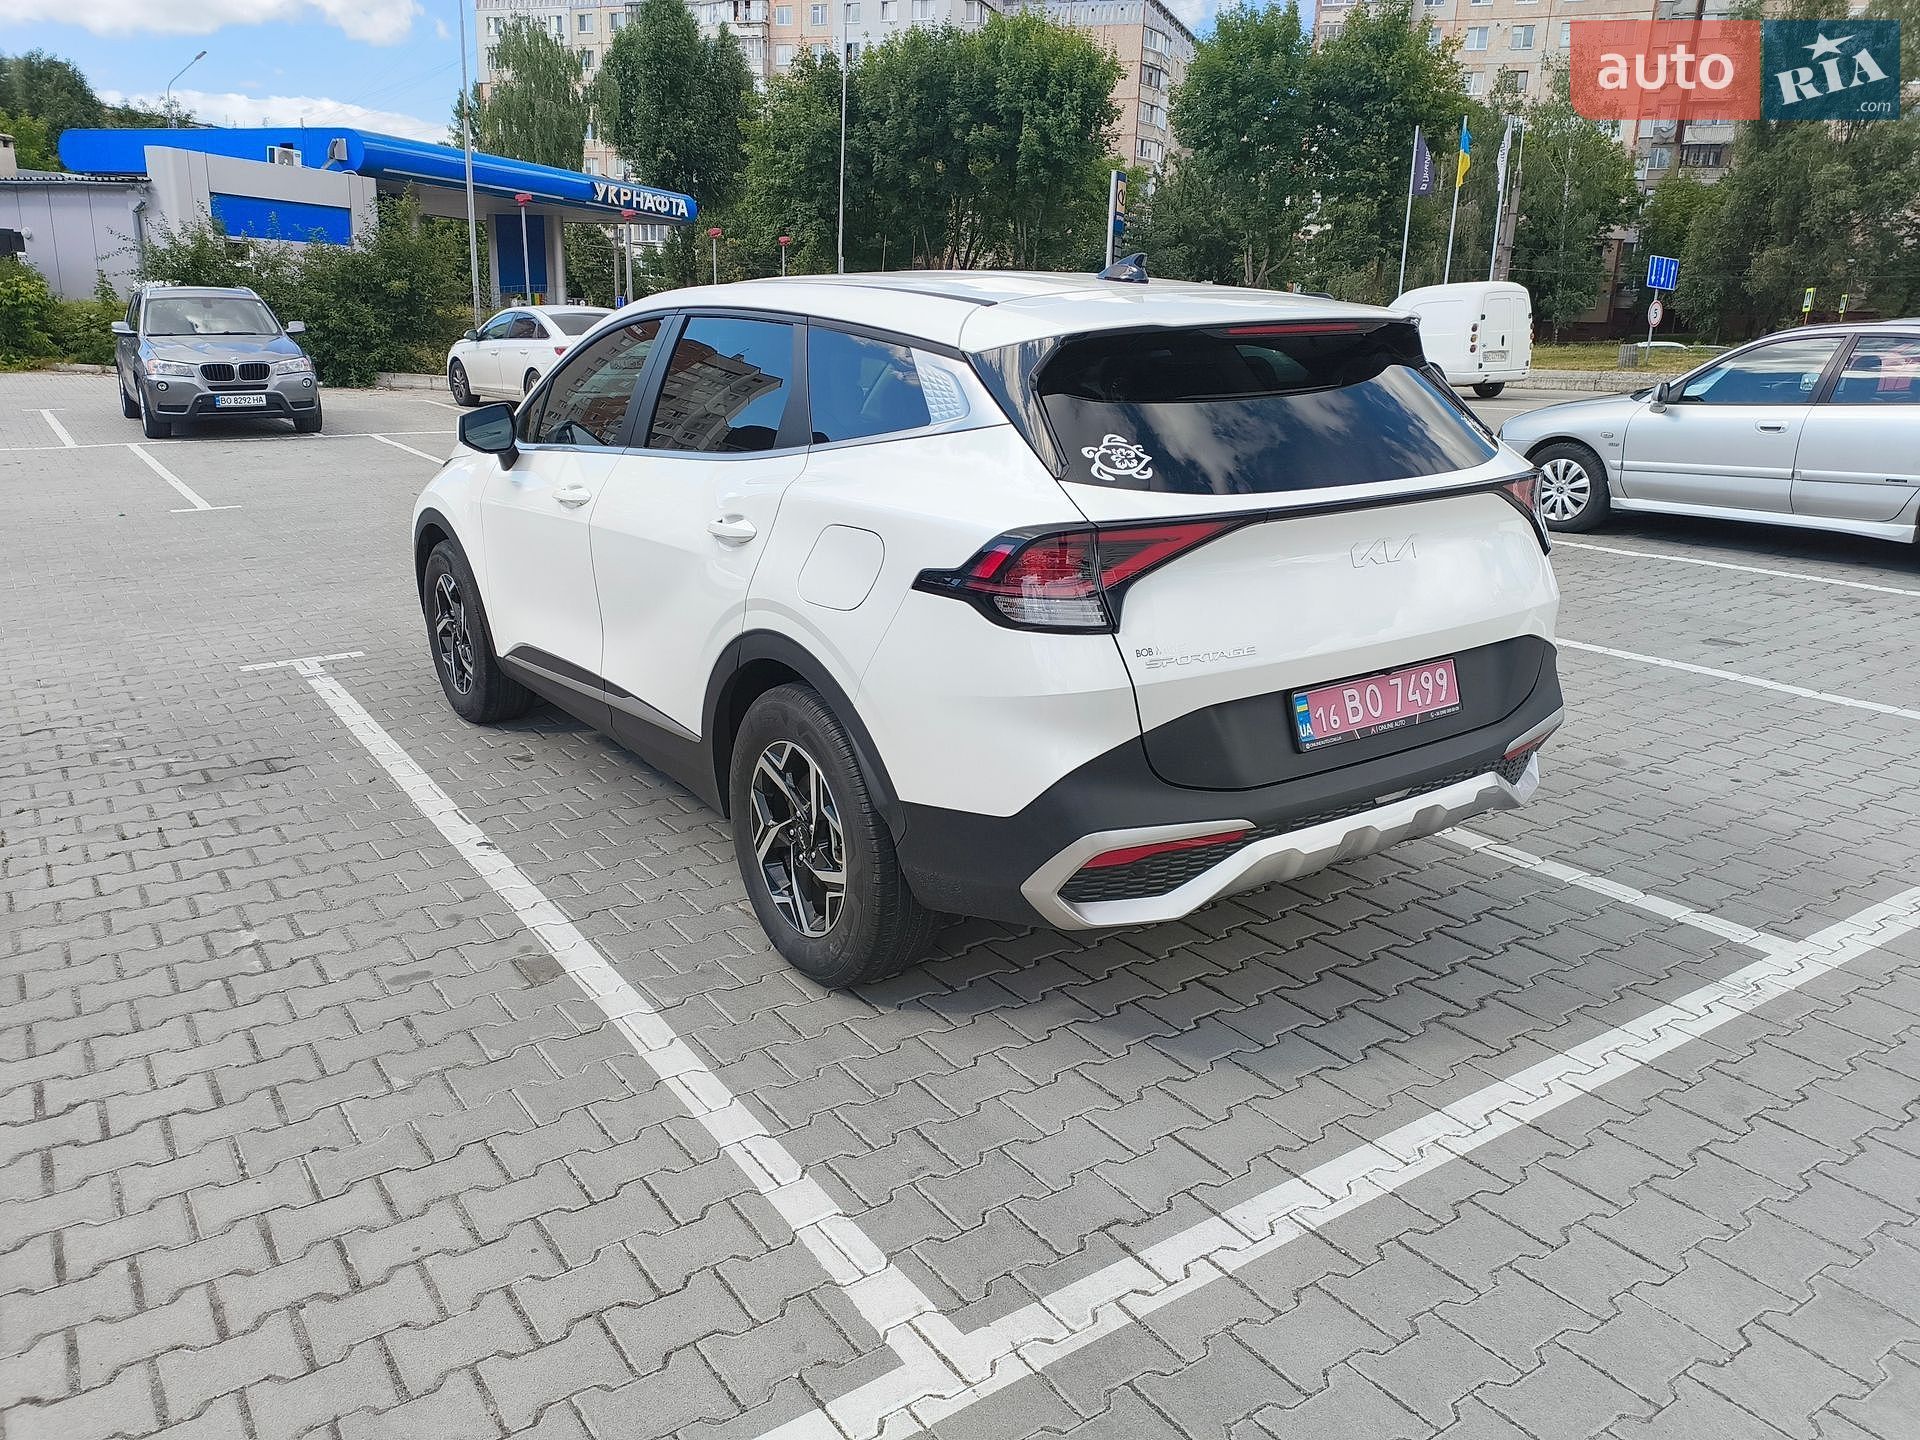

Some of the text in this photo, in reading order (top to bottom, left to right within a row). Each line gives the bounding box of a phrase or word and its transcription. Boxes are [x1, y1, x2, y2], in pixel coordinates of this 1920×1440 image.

[593, 182, 689, 217] УКРНАФТА
[233, 396, 252, 404] 8292
[1145, 646, 1257, 669] SPORTAGE
[1315, 704, 1341, 732] 16
[1389, 667, 1449, 713] 7499
[1299, 723, 1314, 737] UA
[1378, 719, 1406, 731] ONLINE AUTO
